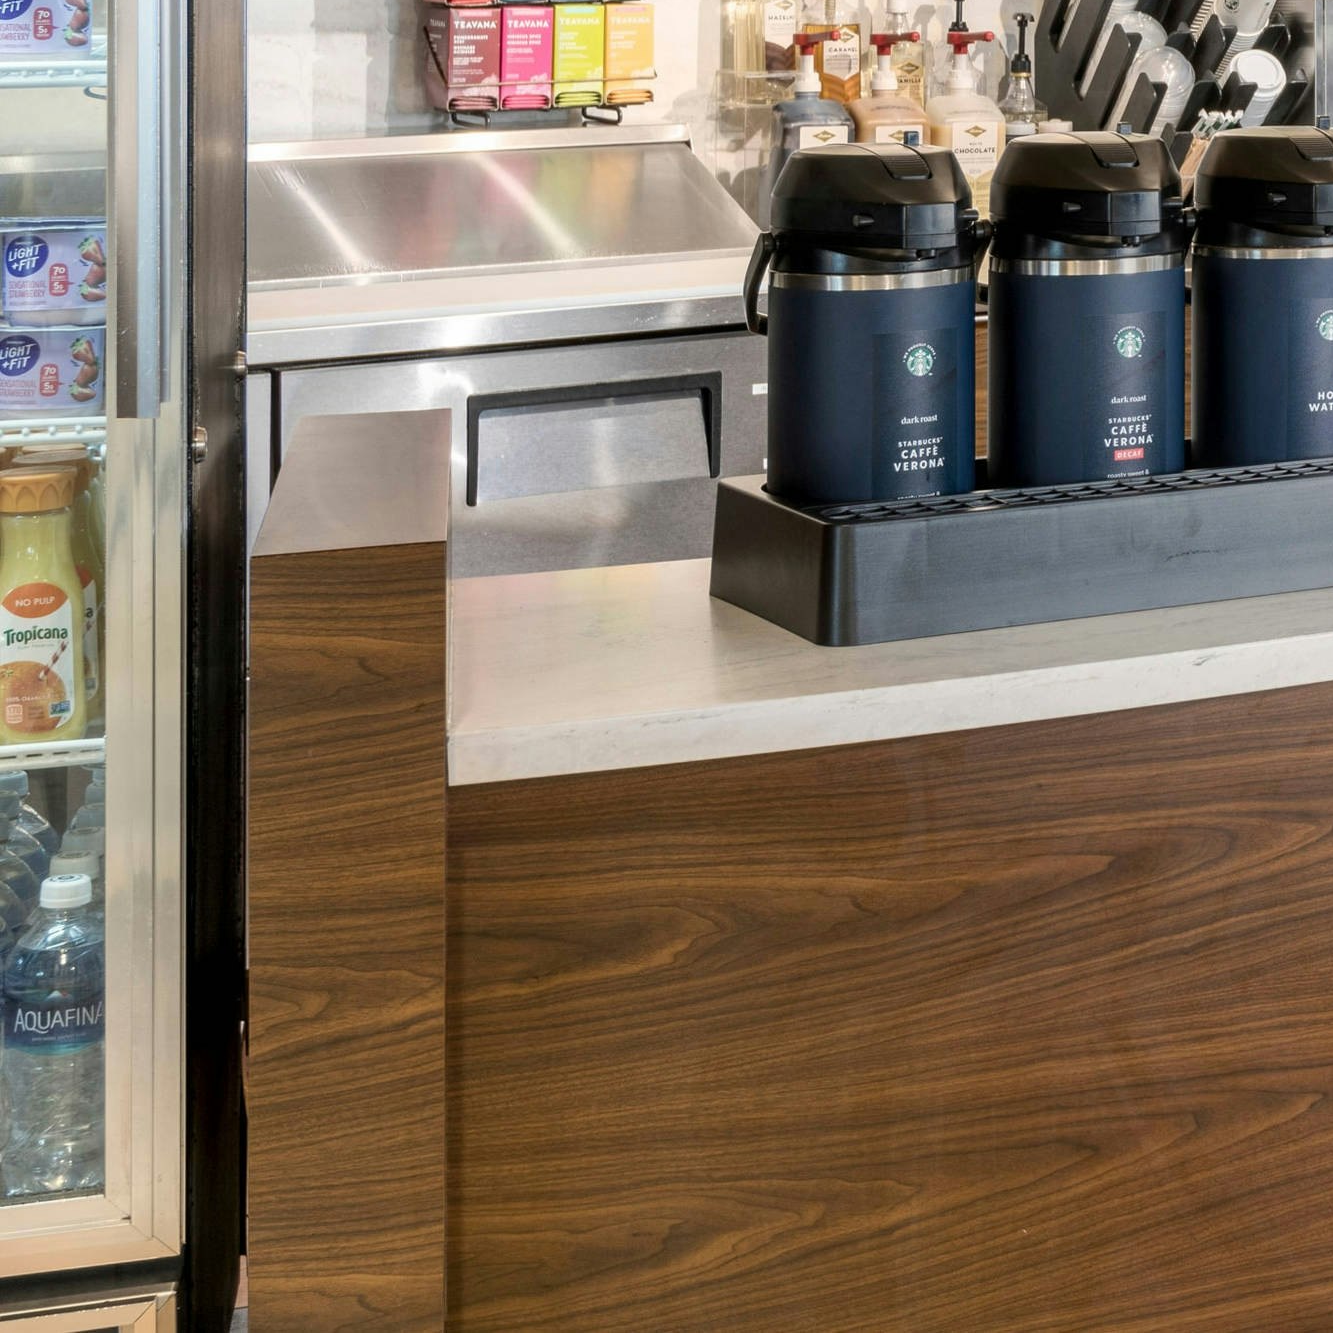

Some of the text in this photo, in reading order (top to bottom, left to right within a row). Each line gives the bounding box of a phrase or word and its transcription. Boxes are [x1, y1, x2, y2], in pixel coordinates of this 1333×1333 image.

[453, 20, 497, 29] TEAVANA
[507, 20, 549, 28] TEAVANA
[559, 17, 600, 25] TEAVANA
[954, 146, 996, 154] CHOCOLATE
[52, 266, 66, 276] 70
[1111, 394, 1147, 404] dark roast
[901, 414, 938, 425] dark roast
[1108, 415, 1150, 424] STARBUCKS
[1111, 422, 1147, 435] CAFFÈ
[898, 437, 941, 448] STARBUCKS
[1104, 434, 1153, 447] VERONA
[901, 445, 938, 459] CAFFÈ
[1117, 451, 1141, 459] DECAF
[893, 457, 944, 472] VERONA
[15, 596, 56, 607] NO PULP
[4, 625, 69, 647] Tropicana
